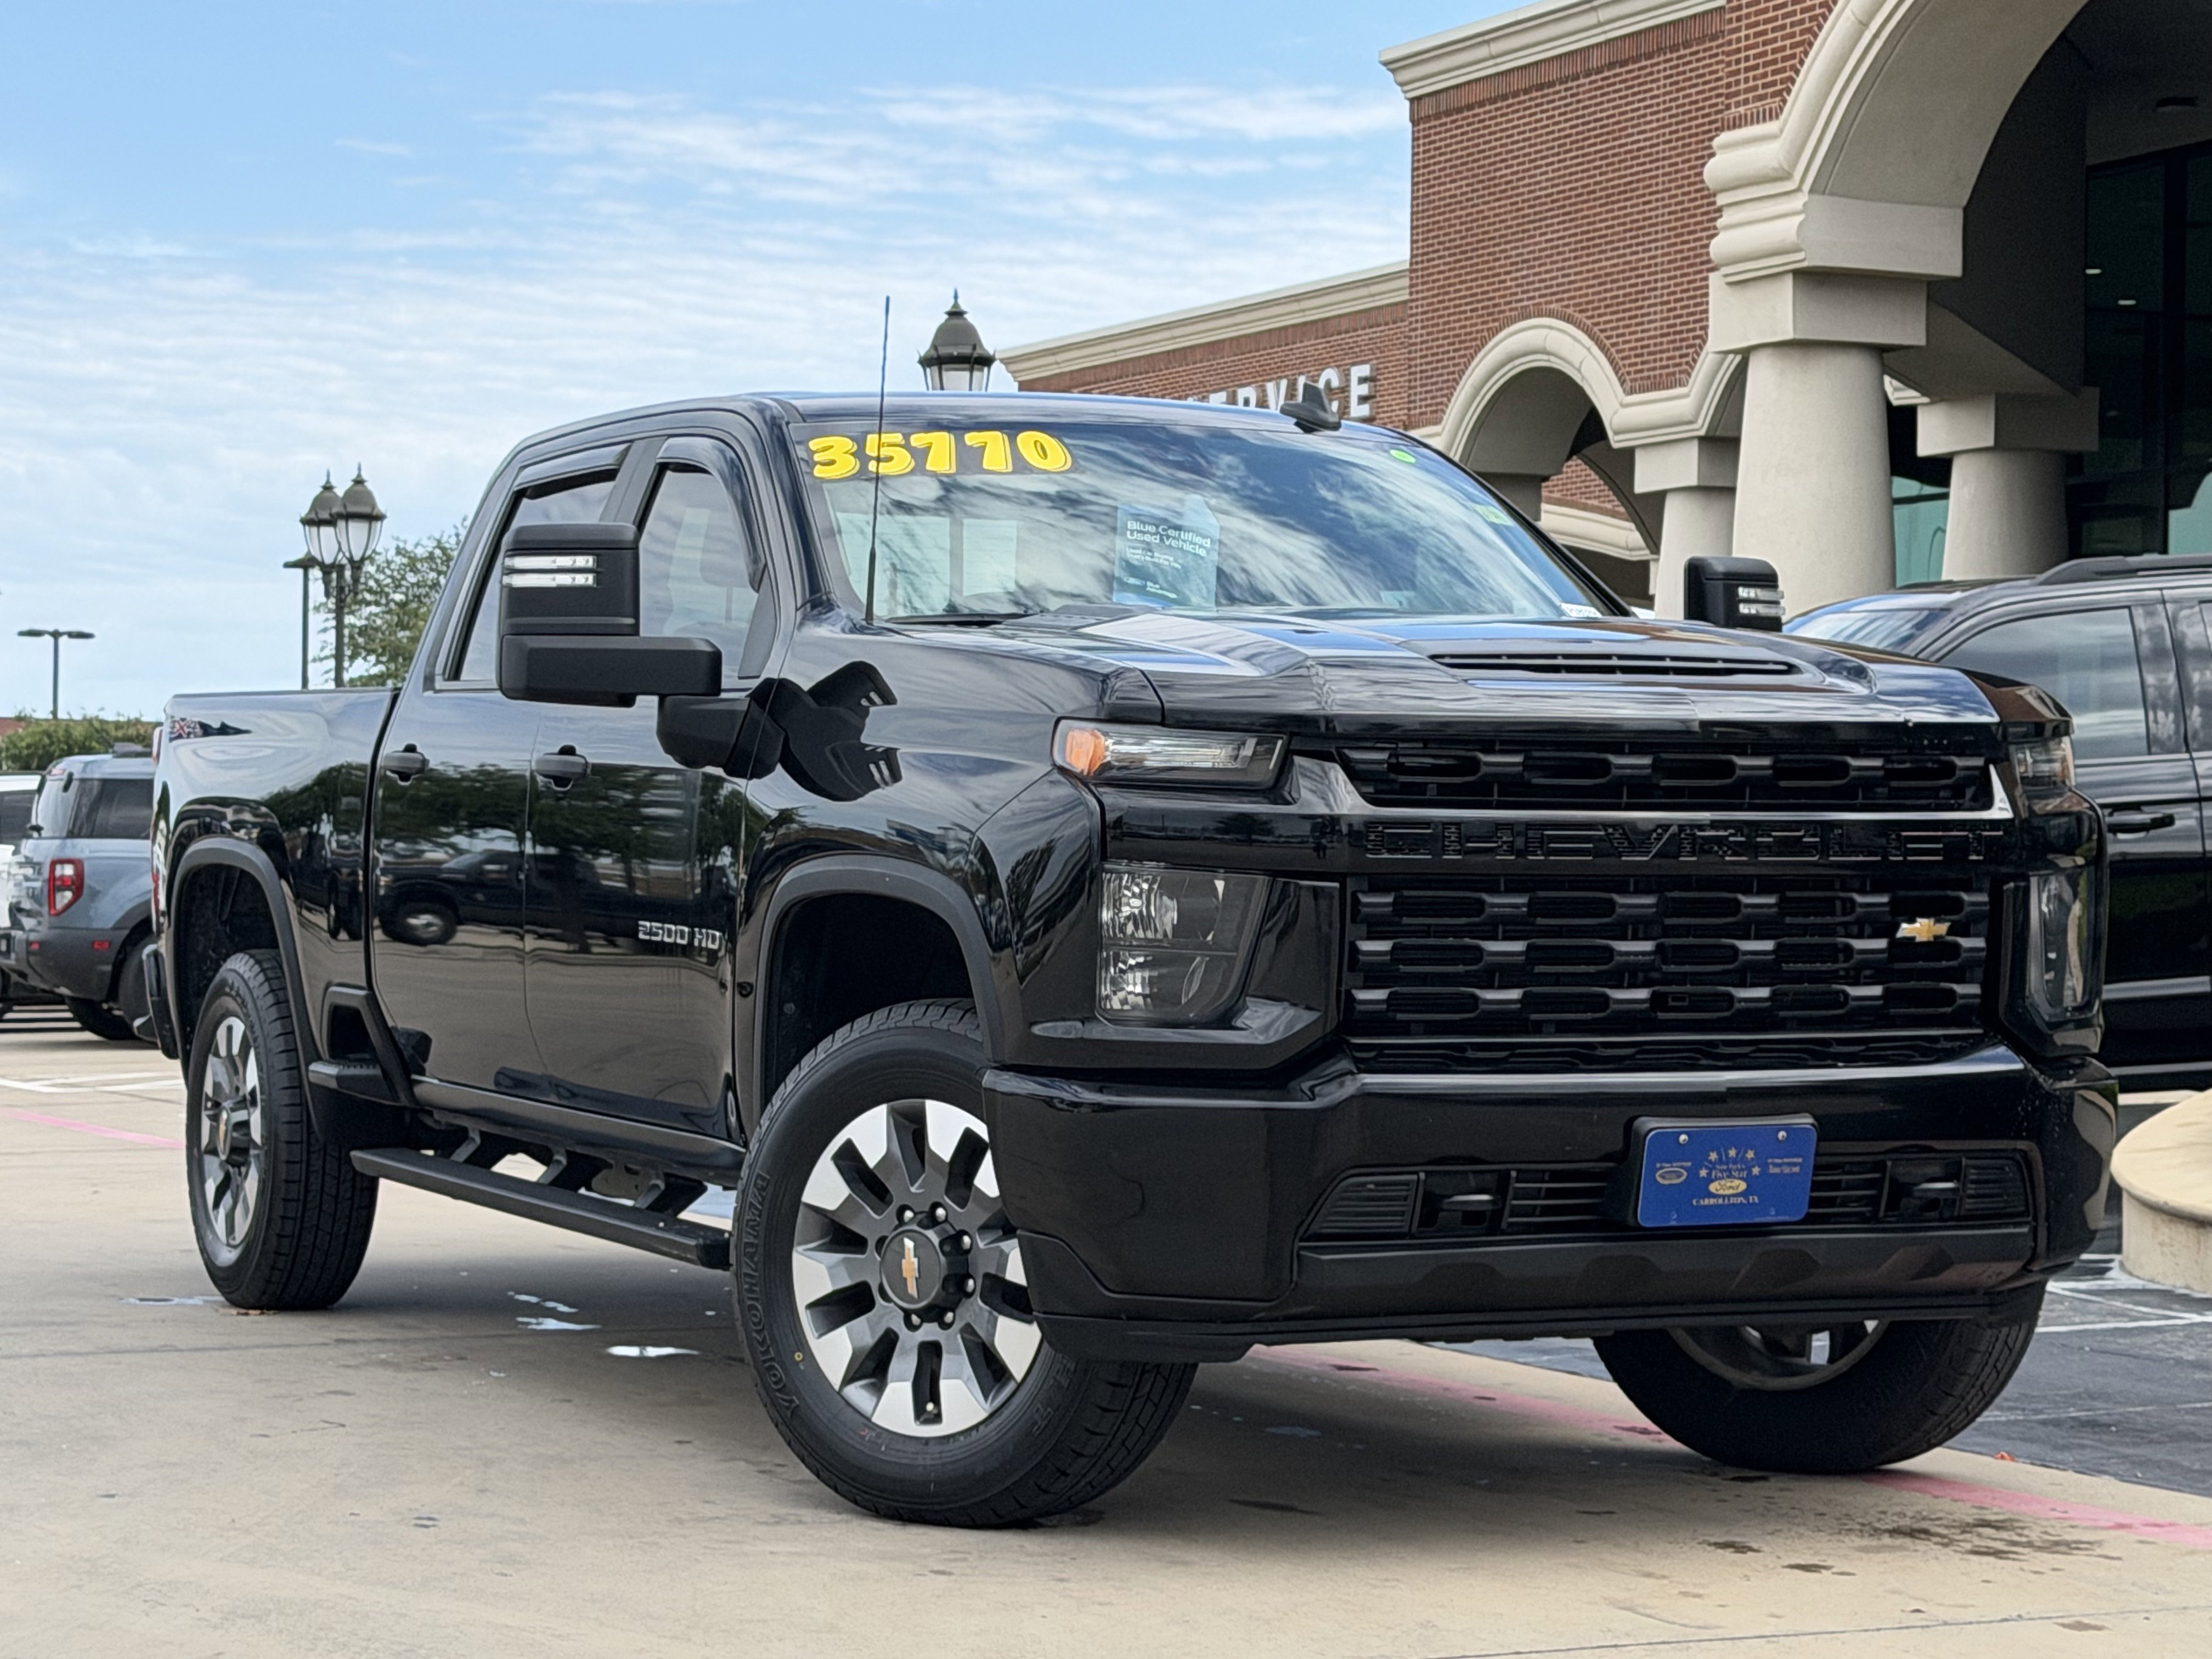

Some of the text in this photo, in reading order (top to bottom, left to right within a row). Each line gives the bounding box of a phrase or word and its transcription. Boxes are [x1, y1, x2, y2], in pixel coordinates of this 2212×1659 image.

[1187, 364, 1370, 417] RVICE
[808, 430, 1072, 479] 35770
[1126, 531, 1207, 557] Used Vehicle
[1127, 521, 1211, 548] Blue Certified
[1365, 823, 2004, 860] CHEVROLET
[638, 920, 720, 949] 2500 HD
[742, 1171, 800, 1420] YOKOHAMA
